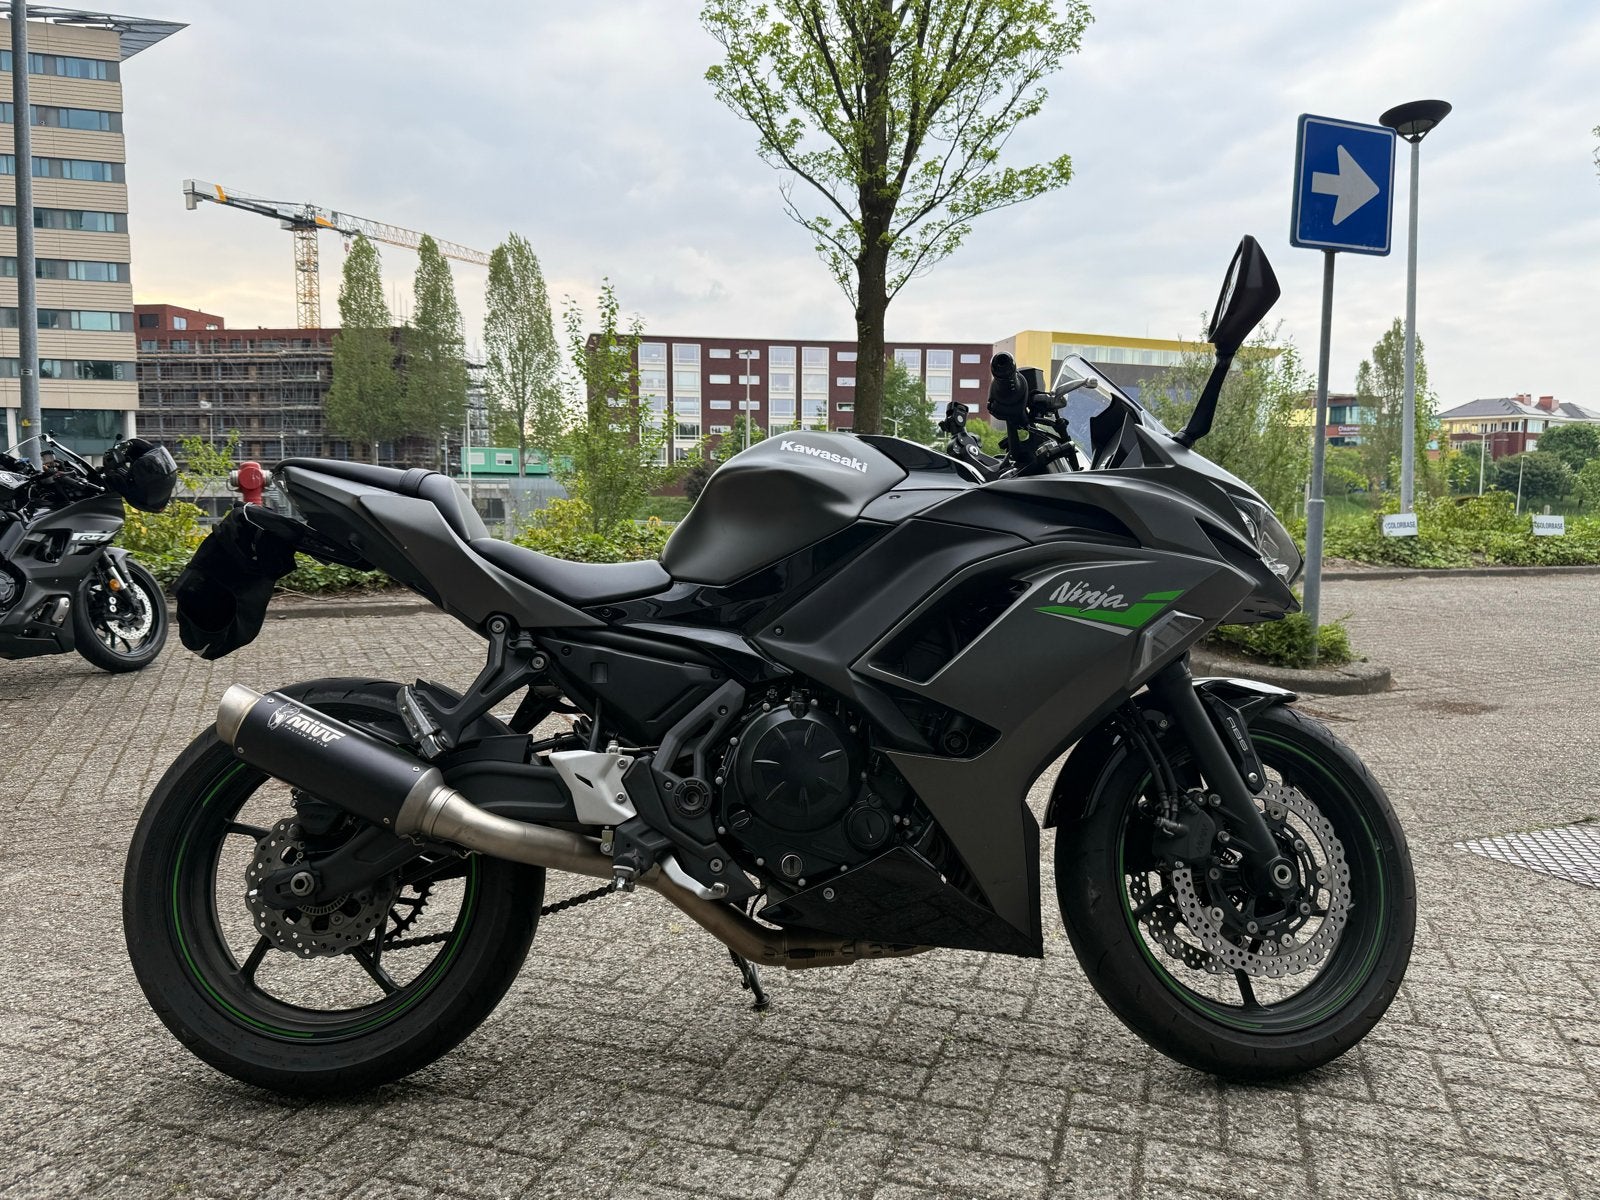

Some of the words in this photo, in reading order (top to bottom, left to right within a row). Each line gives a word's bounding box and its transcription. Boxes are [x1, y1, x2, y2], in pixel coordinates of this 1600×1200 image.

[780, 441, 868, 473] Kawasaki
[1049, 581, 1128, 613] Ninja
[1226, 716, 1249, 752] ABS
